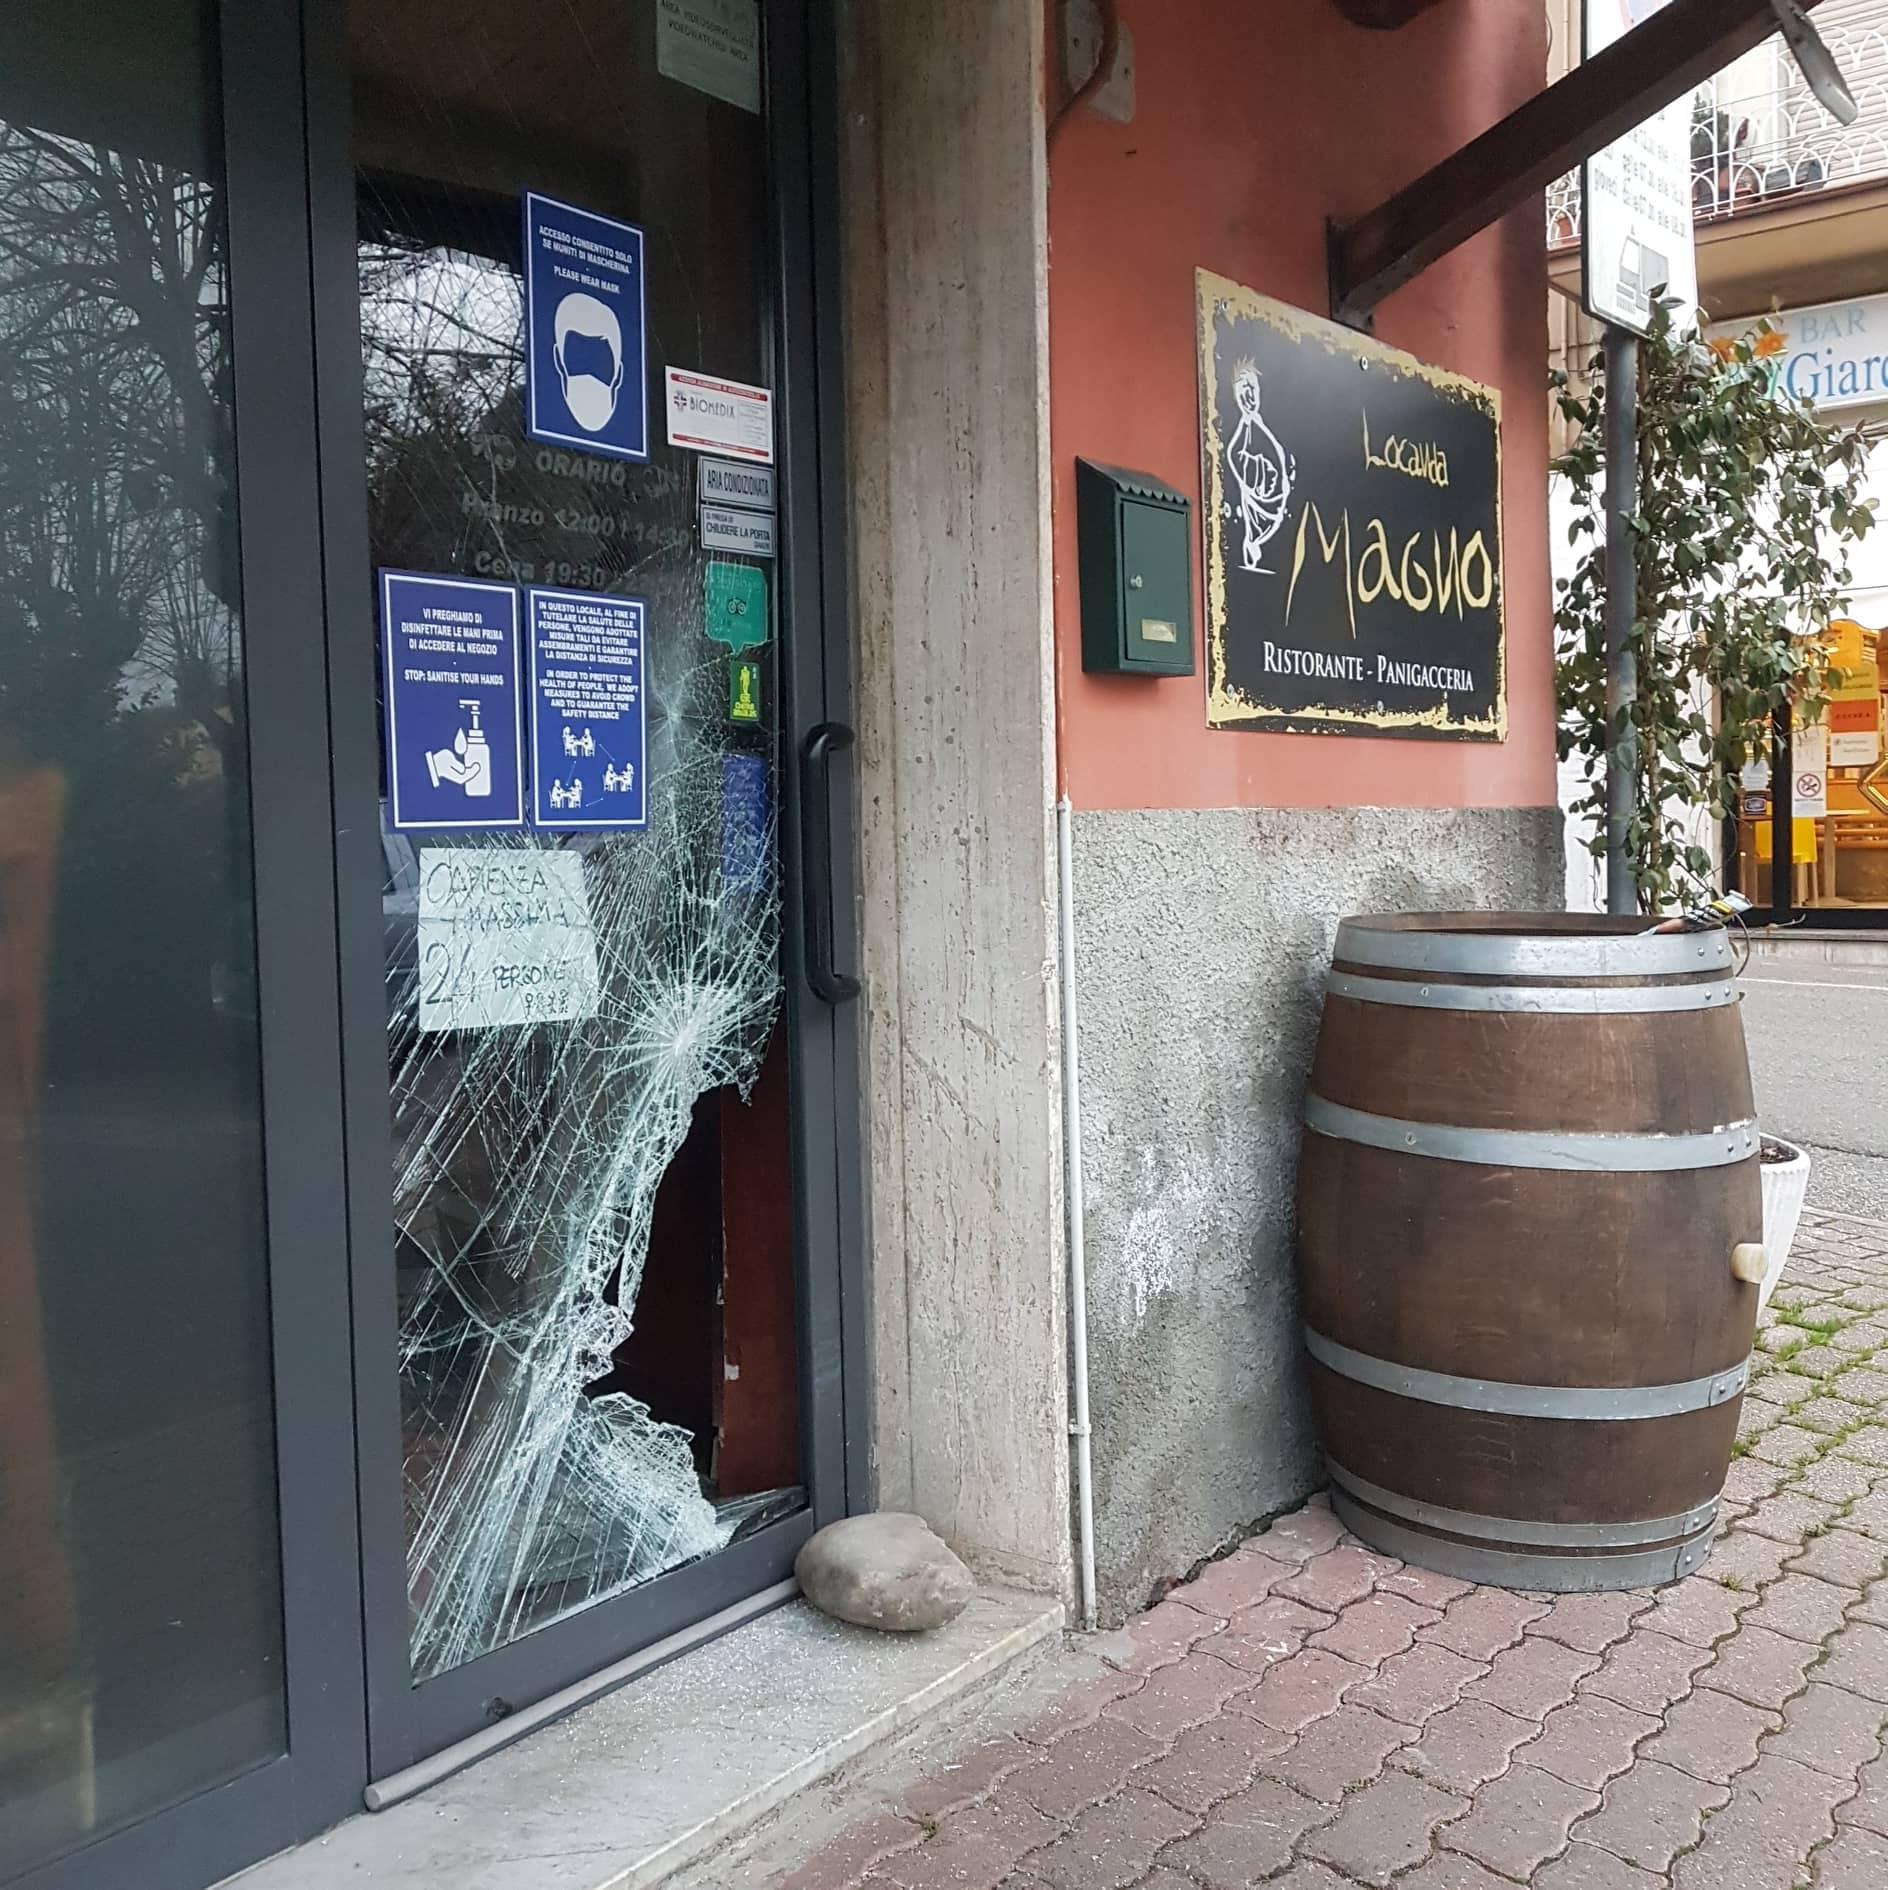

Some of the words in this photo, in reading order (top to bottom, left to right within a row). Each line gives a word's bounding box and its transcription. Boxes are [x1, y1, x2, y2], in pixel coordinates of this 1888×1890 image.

[539, 225, 571, 243] ACCESSO
[572, 236, 614, 258] CONSENTITO
[615, 251, 632, 264] SOLO
[543, 238, 552, 249] SE
[553, 241, 577, 257] MUNITI
[579, 250, 585, 260] DI
[587, 252, 630, 274] MASCHERINA
[554, 265, 579, 281] PLEASE
[580, 274, 600, 288] WEAR
[601, 281, 620, 294] MASK
[1800, 304, 1866, 343] BAR
[690, 396, 735, 418] BIOMEDIX
[1363, 406, 1450, 487] Locanda
[535, 451, 626, 486] ORARIO
[707, 469, 723, 490] ARIA
[725, 472, 769, 497] CONDIZIONATA
[706, 522, 738, 537] CHIUDERE
[740, 526, 748, 537] LA
[750, 528, 770, 540] PORTA
[423, 608, 431, 619] VI
[432, 609, 473, 622] PREGHIAMO
[475, 614, 482, 624] DI
[539, 601, 546, 610] IN
[548, 602, 575, 613] QUESTO
[605, 609, 613, 617] AL
[614, 610, 628, 618] FINE
[630, 611, 636, 619] DI
[542, 612, 577, 622] TUTELARE
[578, 615, 587, 624] LA
[589, 616, 613, 626] SALUTE
[614, 619, 634, 628] DELLE
[401, 622, 451, 636] DISINFETTARE
[453, 627, 462, 637] LE
[464, 628, 480, 638] MANI
[482, 629, 503, 640] PRIMA
[549, 632, 575, 642] MISURE
[576, 634, 590, 642] TALI
[602, 636, 628, 646] EVITARE
[573, 625, 605, 634] VENGONO
[606, 627, 638, 638] ADOTTATE
[409, 638, 417, 649] DI
[418, 639, 455, 652] ACCEDERE
[457, 642, 465, 652] AL
[467, 644, 497, 655] NEGOZIO
[539, 640, 595, 653] ASSEMBRAMENTI
[596, 645, 601, 653] E
[602, 646, 638, 656] GARANTIRE
[545, 650, 555, 658] LA
[556, 651, 588, 661] DISTANZA
[589, 654, 596, 662] DI
[598, 655, 633, 665] SICUREZZA
[1264, 642, 1364, 681] RISTORANTE
[1376, 655, 1474, 692] PANIGACCERIA
[405, 669, 425, 681] STOP:
[427, 670, 459, 682] SANITISE
[460, 672, 479, 684] YOUR
[481, 674, 503, 685] HANDS
[555, 670, 577, 679] ORDER
[580, 672, 588, 680] TO
[589, 673, 618, 682] PROTECT
[620, 675, 632, 683] THE
[539, 679, 565, 688] HEALTH
[567, 680, 575, 689] OF
[618, 684, 639, 693] ADOPT
[544, 689, 580, 699] MEASURES
[582, 691, 590, 699] TO
[592, 692, 611, 701] AVOID
[612, 693, 635, 702] CROWD
[551, 699, 565, 708] AND
[567, 700, 575, 708] TO
[577, 701, 615, 710] GUARANTEE
[617, 702, 629, 711] THE
[562, 709, 587, 718] SAFETY
[588, 710, 619, 719] DISTANCE
[427, 862, 548, 903] CAPIENZA
[426, 943, 476, 1004] 24
[493, 960, 566, 992] PERSONE
